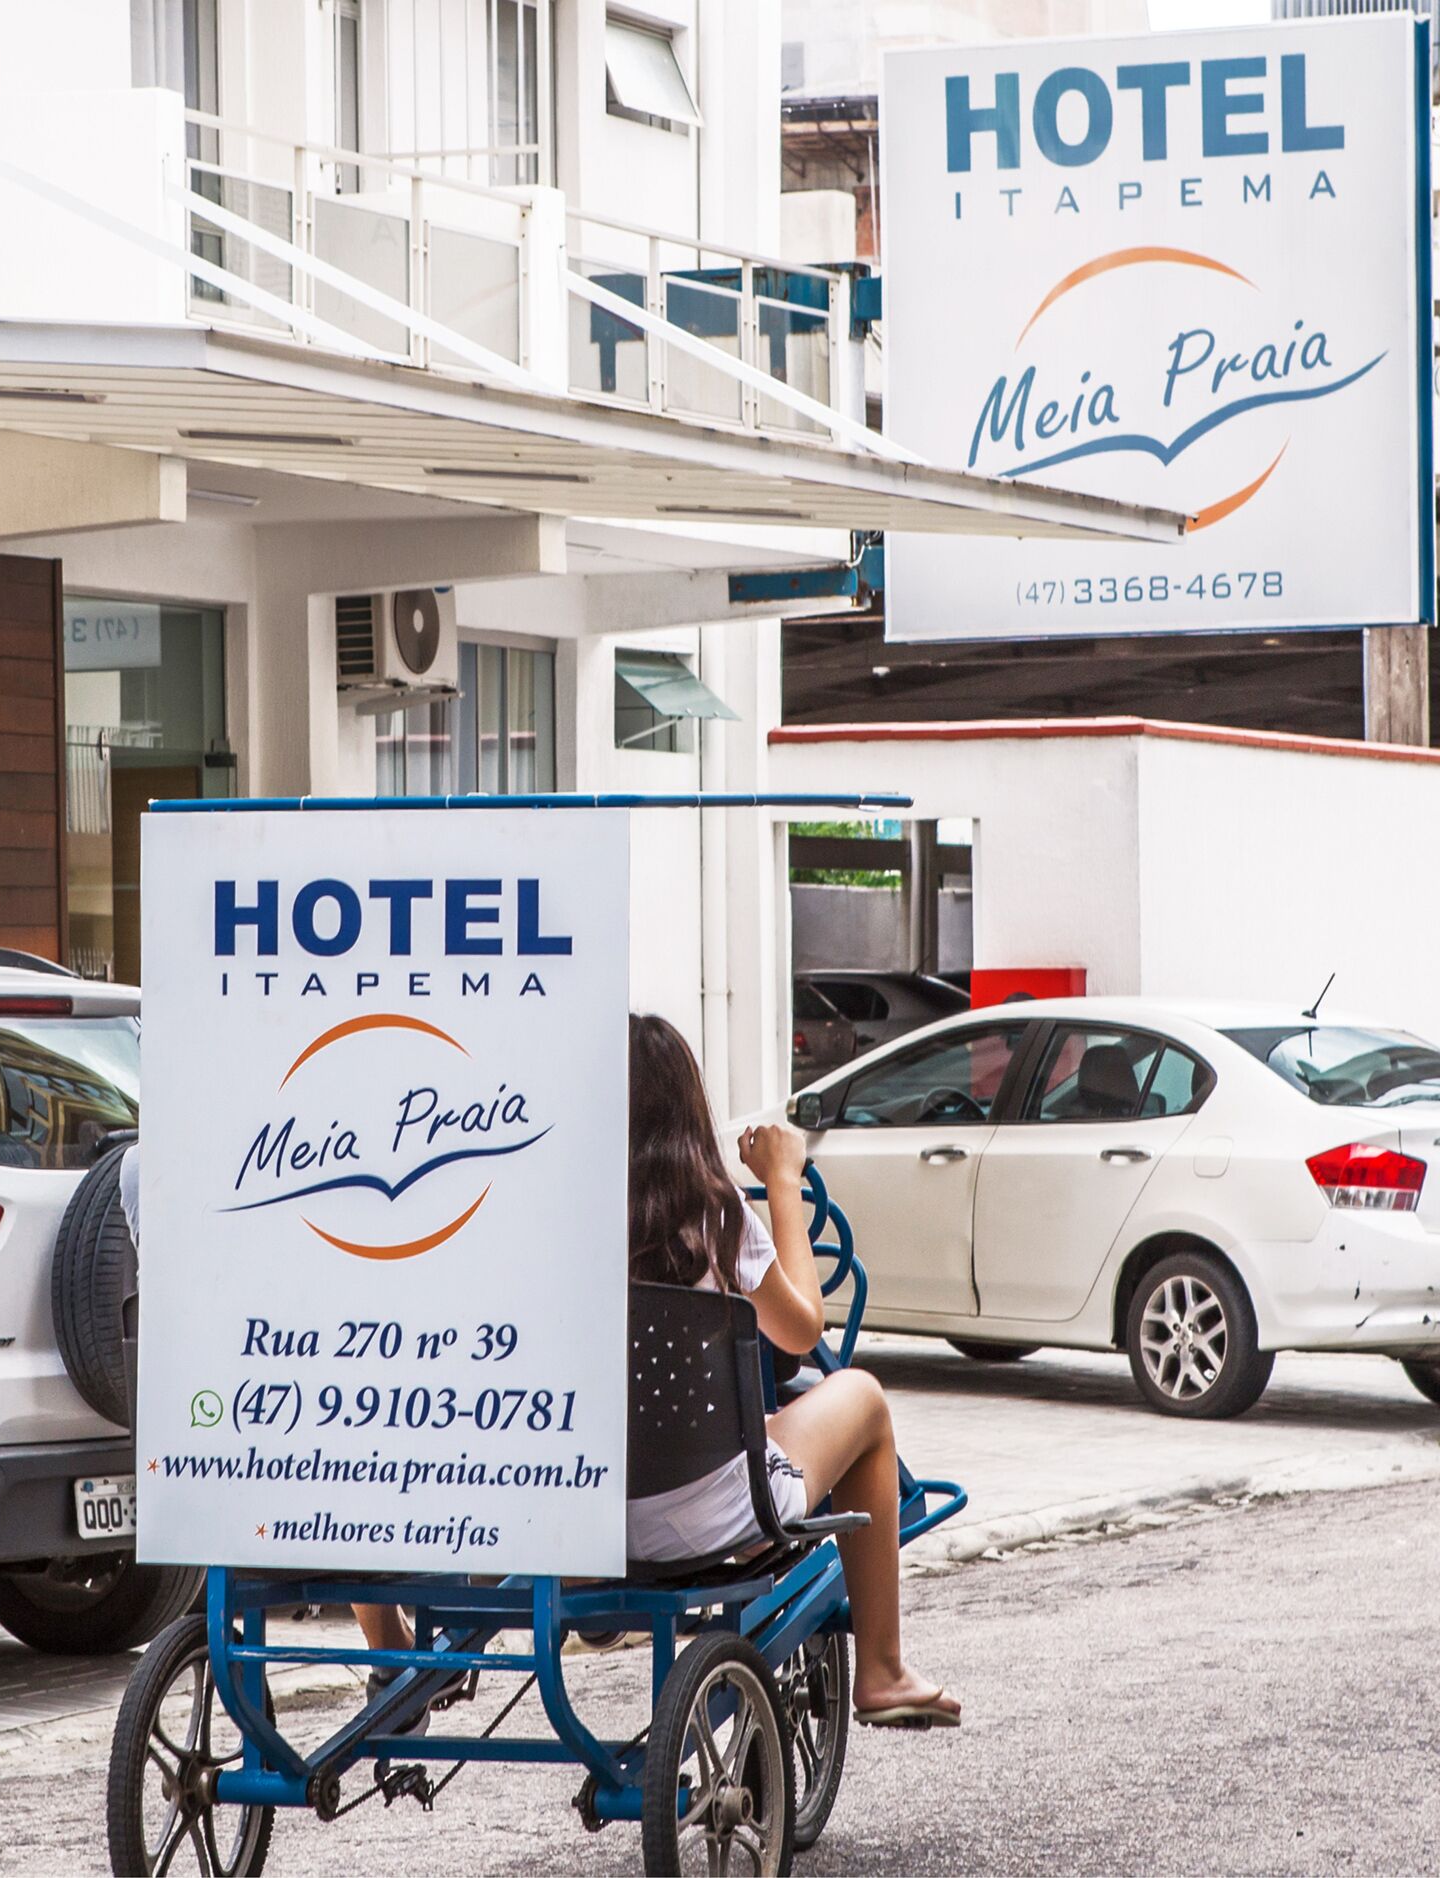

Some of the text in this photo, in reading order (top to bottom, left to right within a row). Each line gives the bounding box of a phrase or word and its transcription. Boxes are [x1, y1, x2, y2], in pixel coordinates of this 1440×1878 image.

[945, 54, 1345, 173] HOTEL
[954, 170, 1337, 220] ITAPEMA
[967, 319, 1333, 468] Meia Praia
[214, 878, 573, 957] HOTEL
[221, 972, 547, 997] ITAPEMA
[234, 1083, 530, 1191] Meia Praia
[240, 1318, 320, 1358] Rua
[333, 1320, 403, 1359] 270
[470, 1322, 518, 1362] 39
[232, 1379, 577, 1435] (47) 9.9103-0781
[162, 1447, 609, 1494] www.hotelmeiapraia.com.br
[272, 1512, 500, 1555] melhores tarifas
